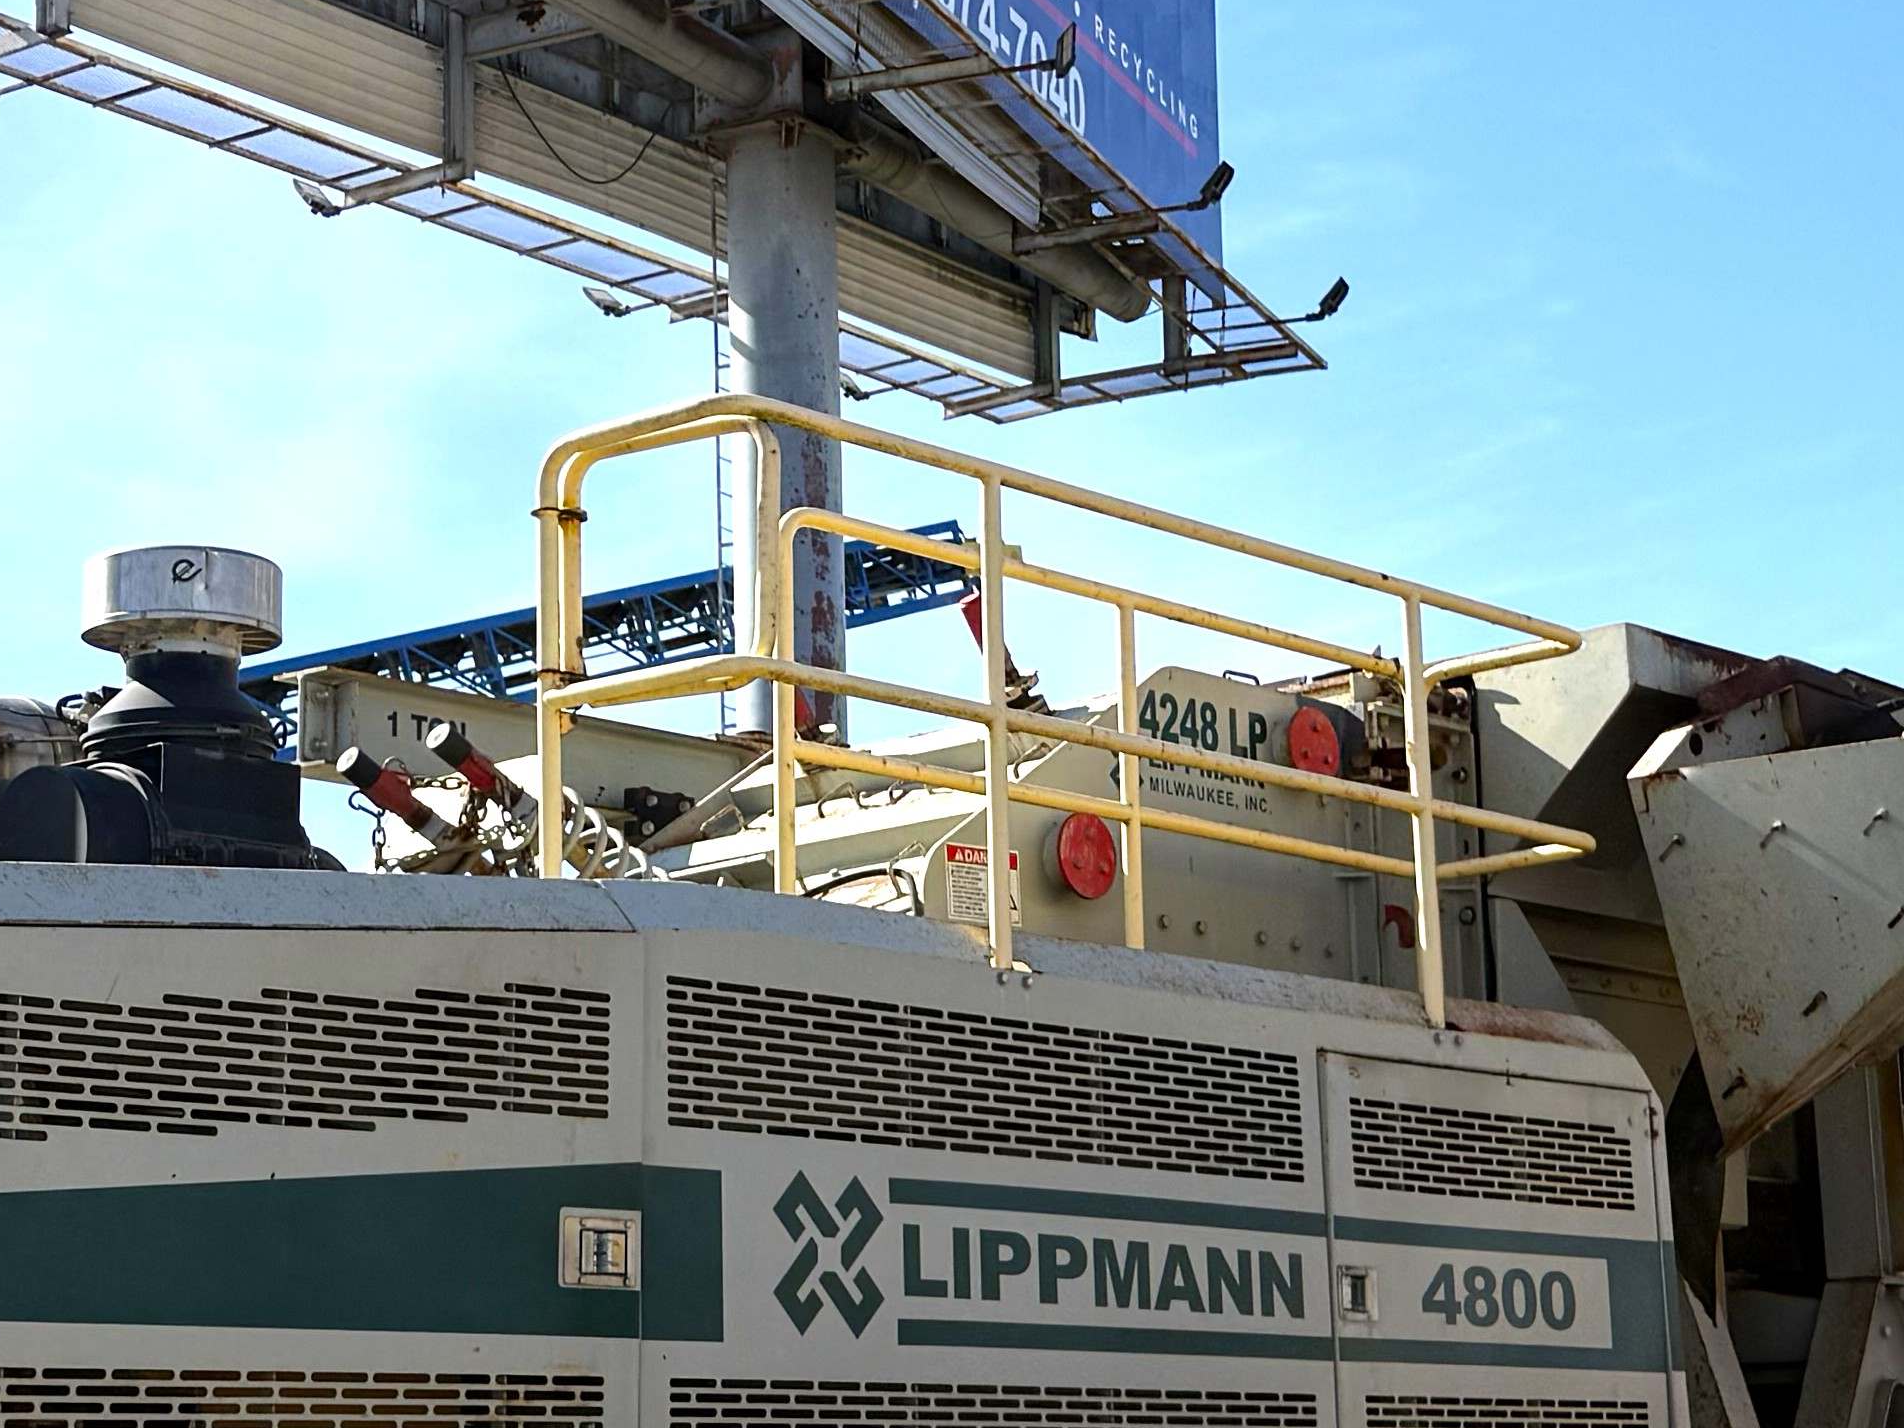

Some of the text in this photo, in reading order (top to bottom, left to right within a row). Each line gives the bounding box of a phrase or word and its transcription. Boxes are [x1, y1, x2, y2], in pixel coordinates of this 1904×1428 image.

[1094, 14, 1199, 140] RECYCLING
[1139, 689, 1268, 761] 4248 LP
[1149, 776, 1273, 815] MILWAUKEE, INC.
[902, 1222, 1577, 1332] LIPPMANN 4800
